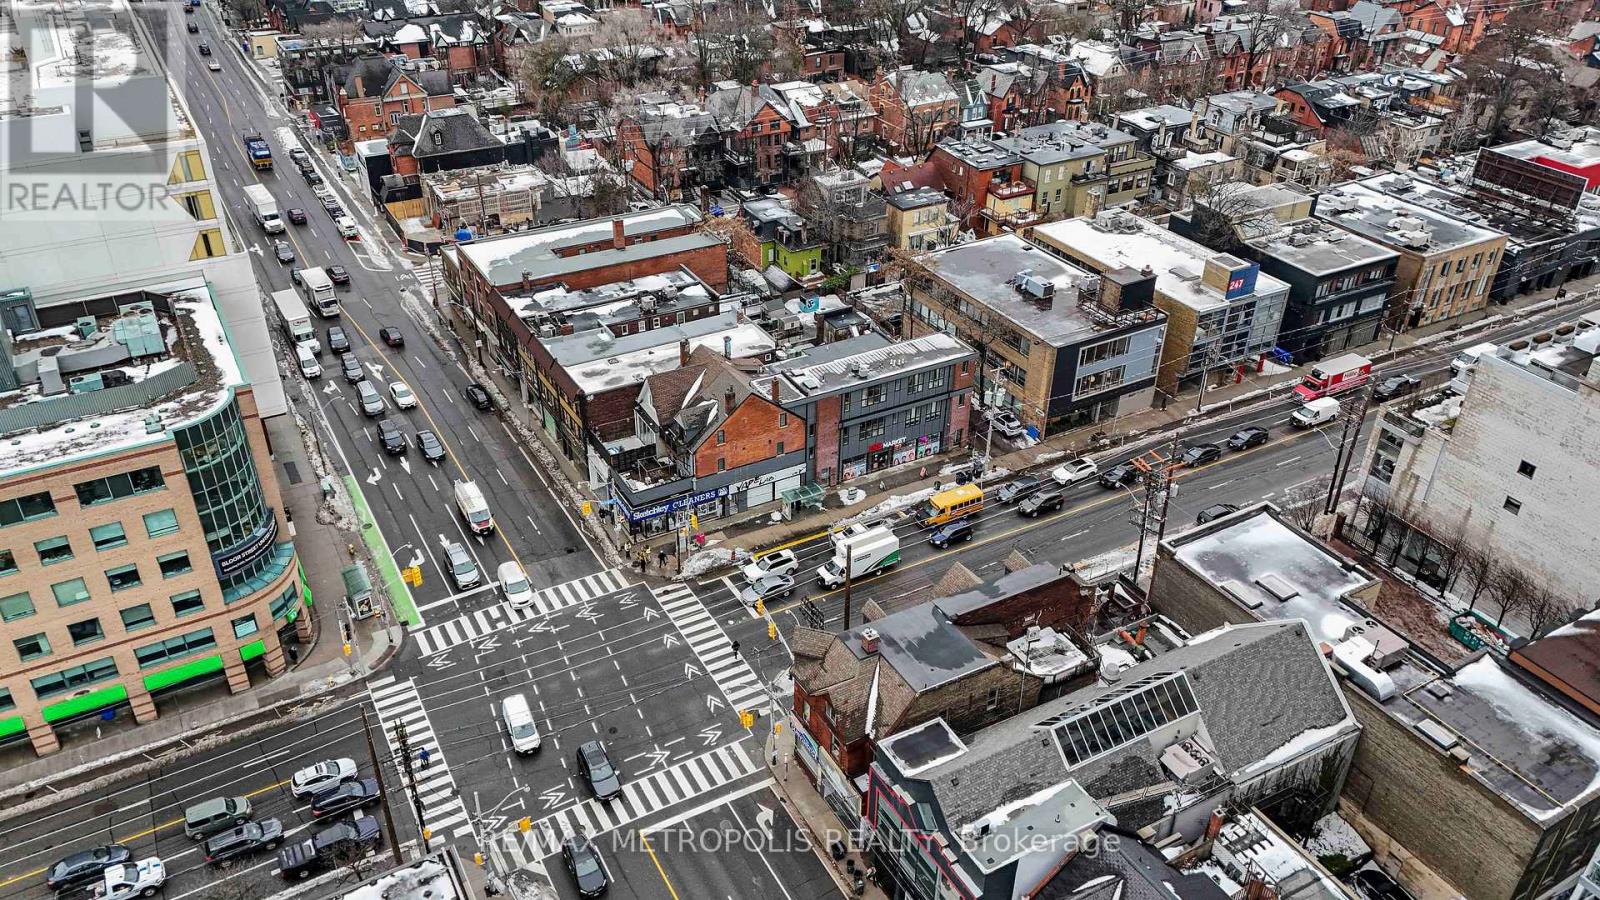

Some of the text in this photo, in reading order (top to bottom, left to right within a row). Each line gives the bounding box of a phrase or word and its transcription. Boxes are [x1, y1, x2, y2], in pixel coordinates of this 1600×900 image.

[1229, 279, 1244, 290] 247
[883, 436, 907, 448] MARKET
[633, 504, 669, 520] Sketchley
[672, 490, 716, 509] CLEANERS
[222, 554, 241, 567] BLOOR
[242, 544, 259, 558] STREET
